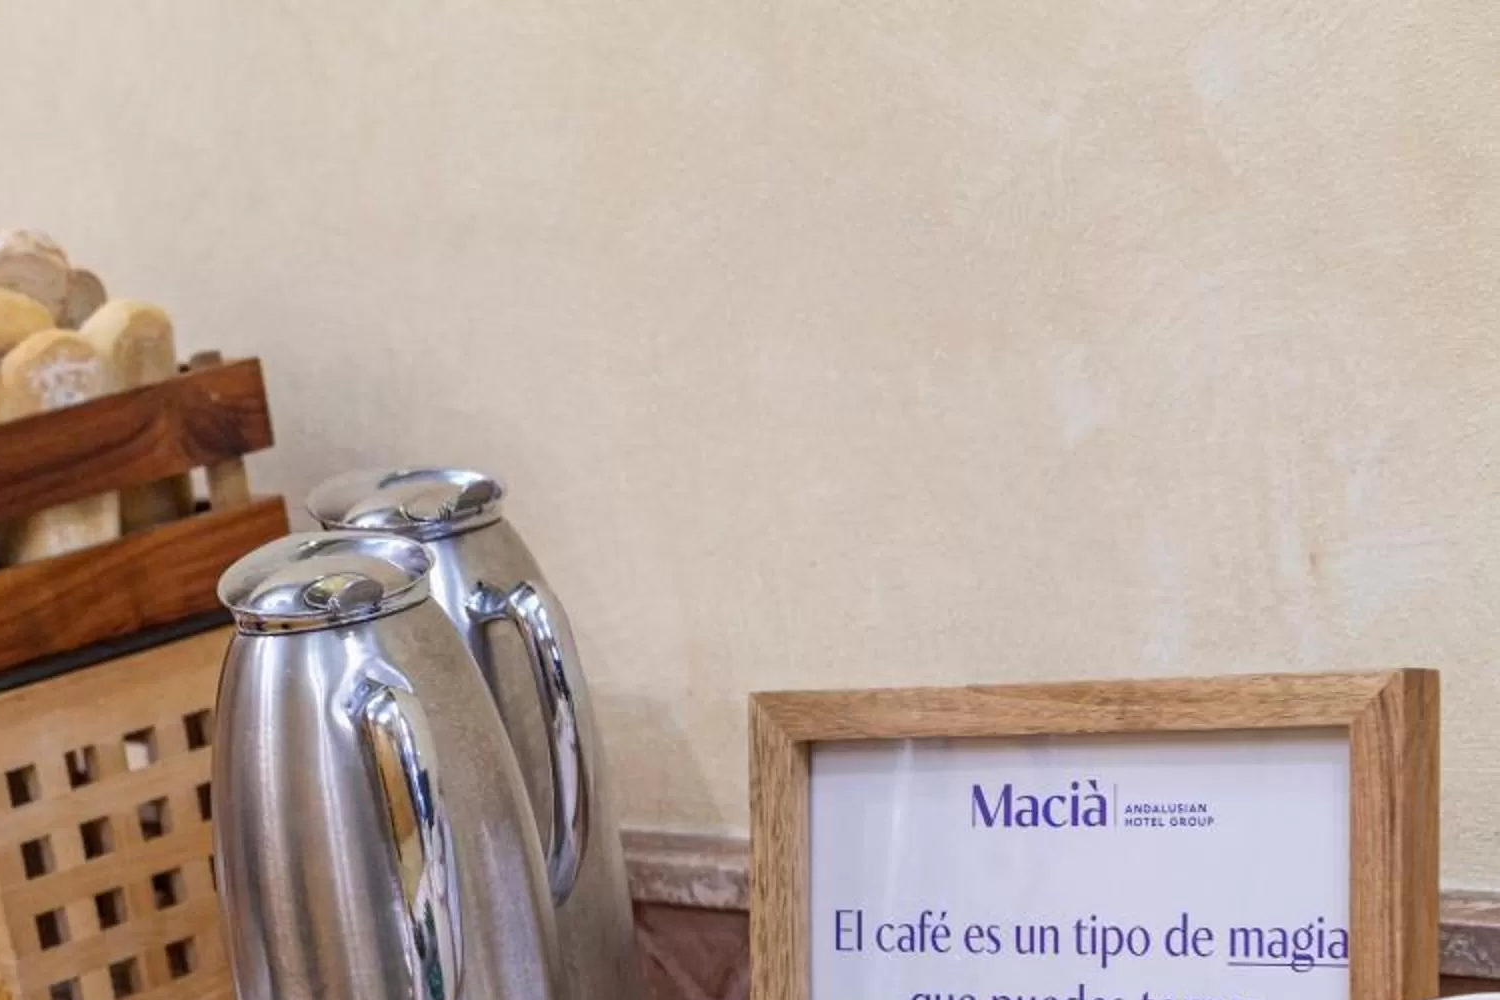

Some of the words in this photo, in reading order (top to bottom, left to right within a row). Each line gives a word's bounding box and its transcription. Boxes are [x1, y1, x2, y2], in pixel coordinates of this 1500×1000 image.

[971, 779, 1107, 829] Macià
[1123, 802, 1208, 815] ANDALUSIAN
[1124, 816, 1166, 828] HOTEL
[1168, 815, 1215, 828] GROUP
[834, 910, 864, 953] El
[875, 910, 952, 954] café
[963, 923, 1002, 955] es
[1015, 924, 1060, 956] un
[1072, 914, 1152, 970] tipo
[1164, 912, 1215, 958] de
[1228, 915, 1349, 974] magia
